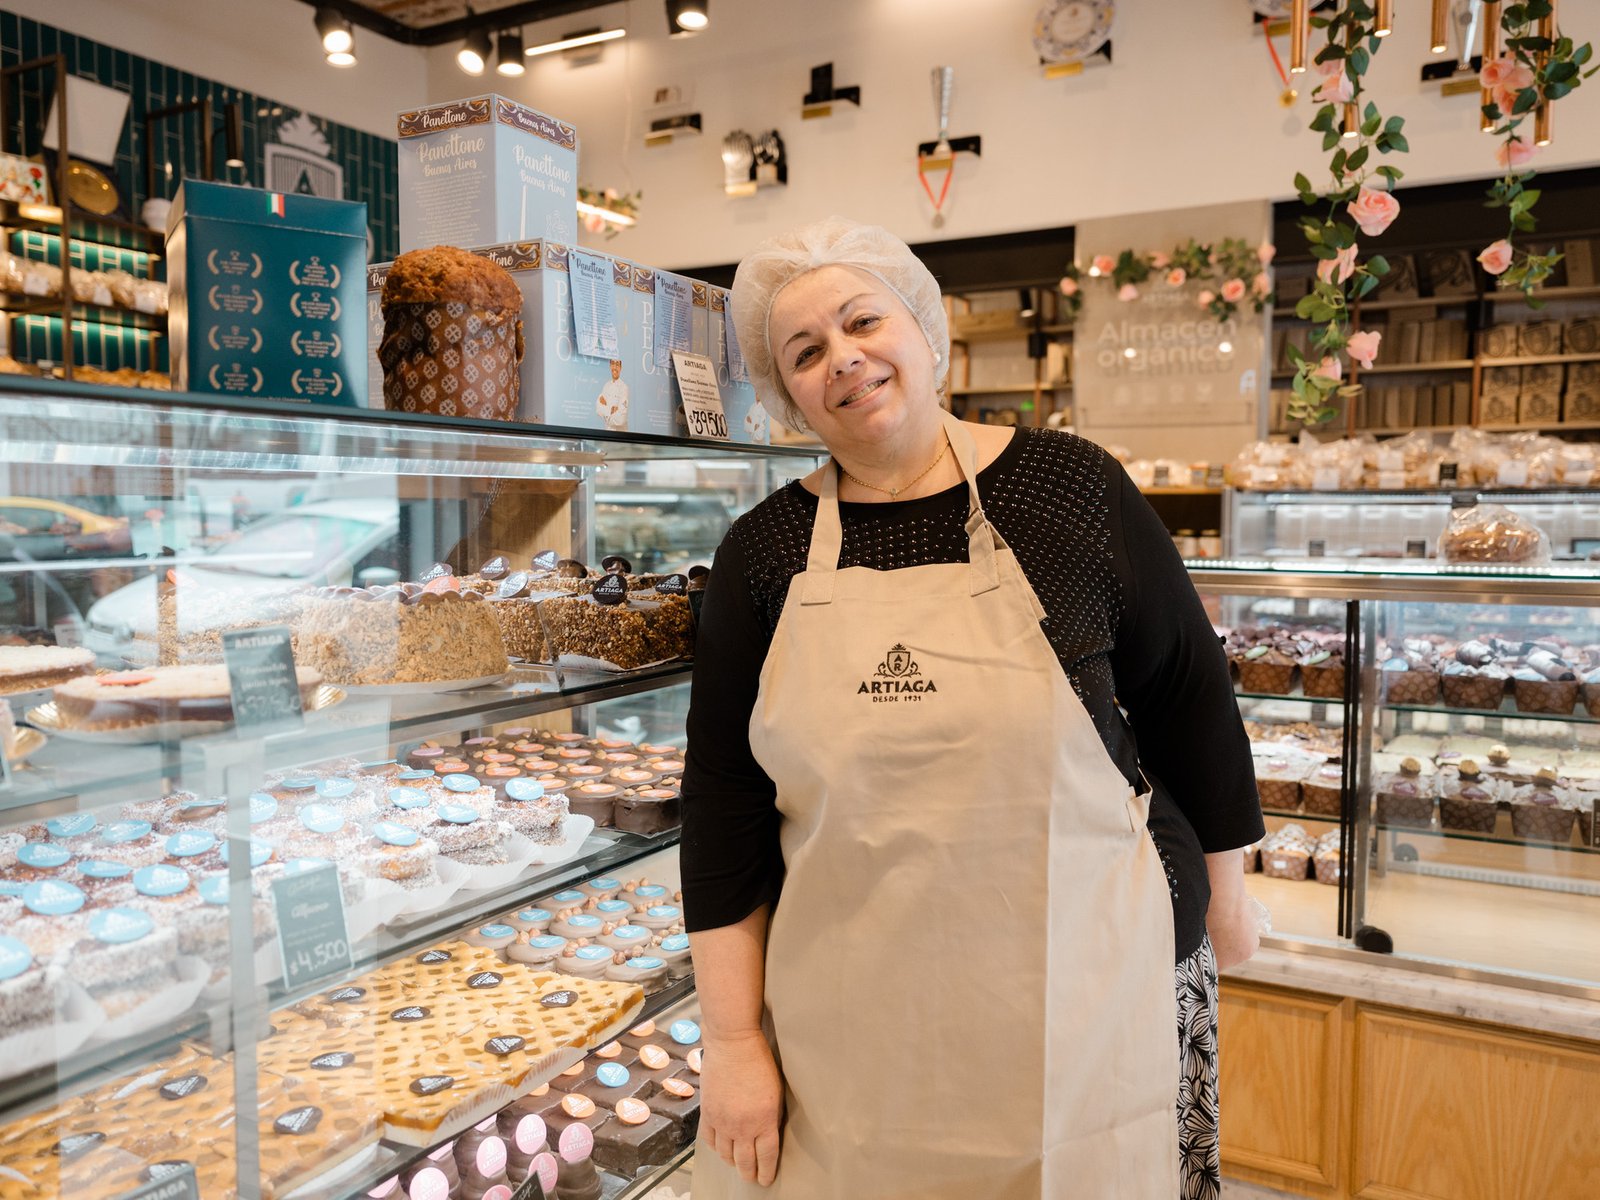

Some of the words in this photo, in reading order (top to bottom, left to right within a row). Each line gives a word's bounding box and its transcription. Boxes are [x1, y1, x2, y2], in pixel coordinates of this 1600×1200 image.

[421, 109, 467, 128] Panettone
[517, 112, 539, 131] Buenos
[416, 133, 486, 163] Panettone
[512, 143, 572, 183] Panettone
[488, 251, 513, 268] ttone
[857, 679, 938, 694] ARTIAGA
[872, 695, 899, 703] DESDE
[564, 1139, 591, 1153] ARTIAGA
